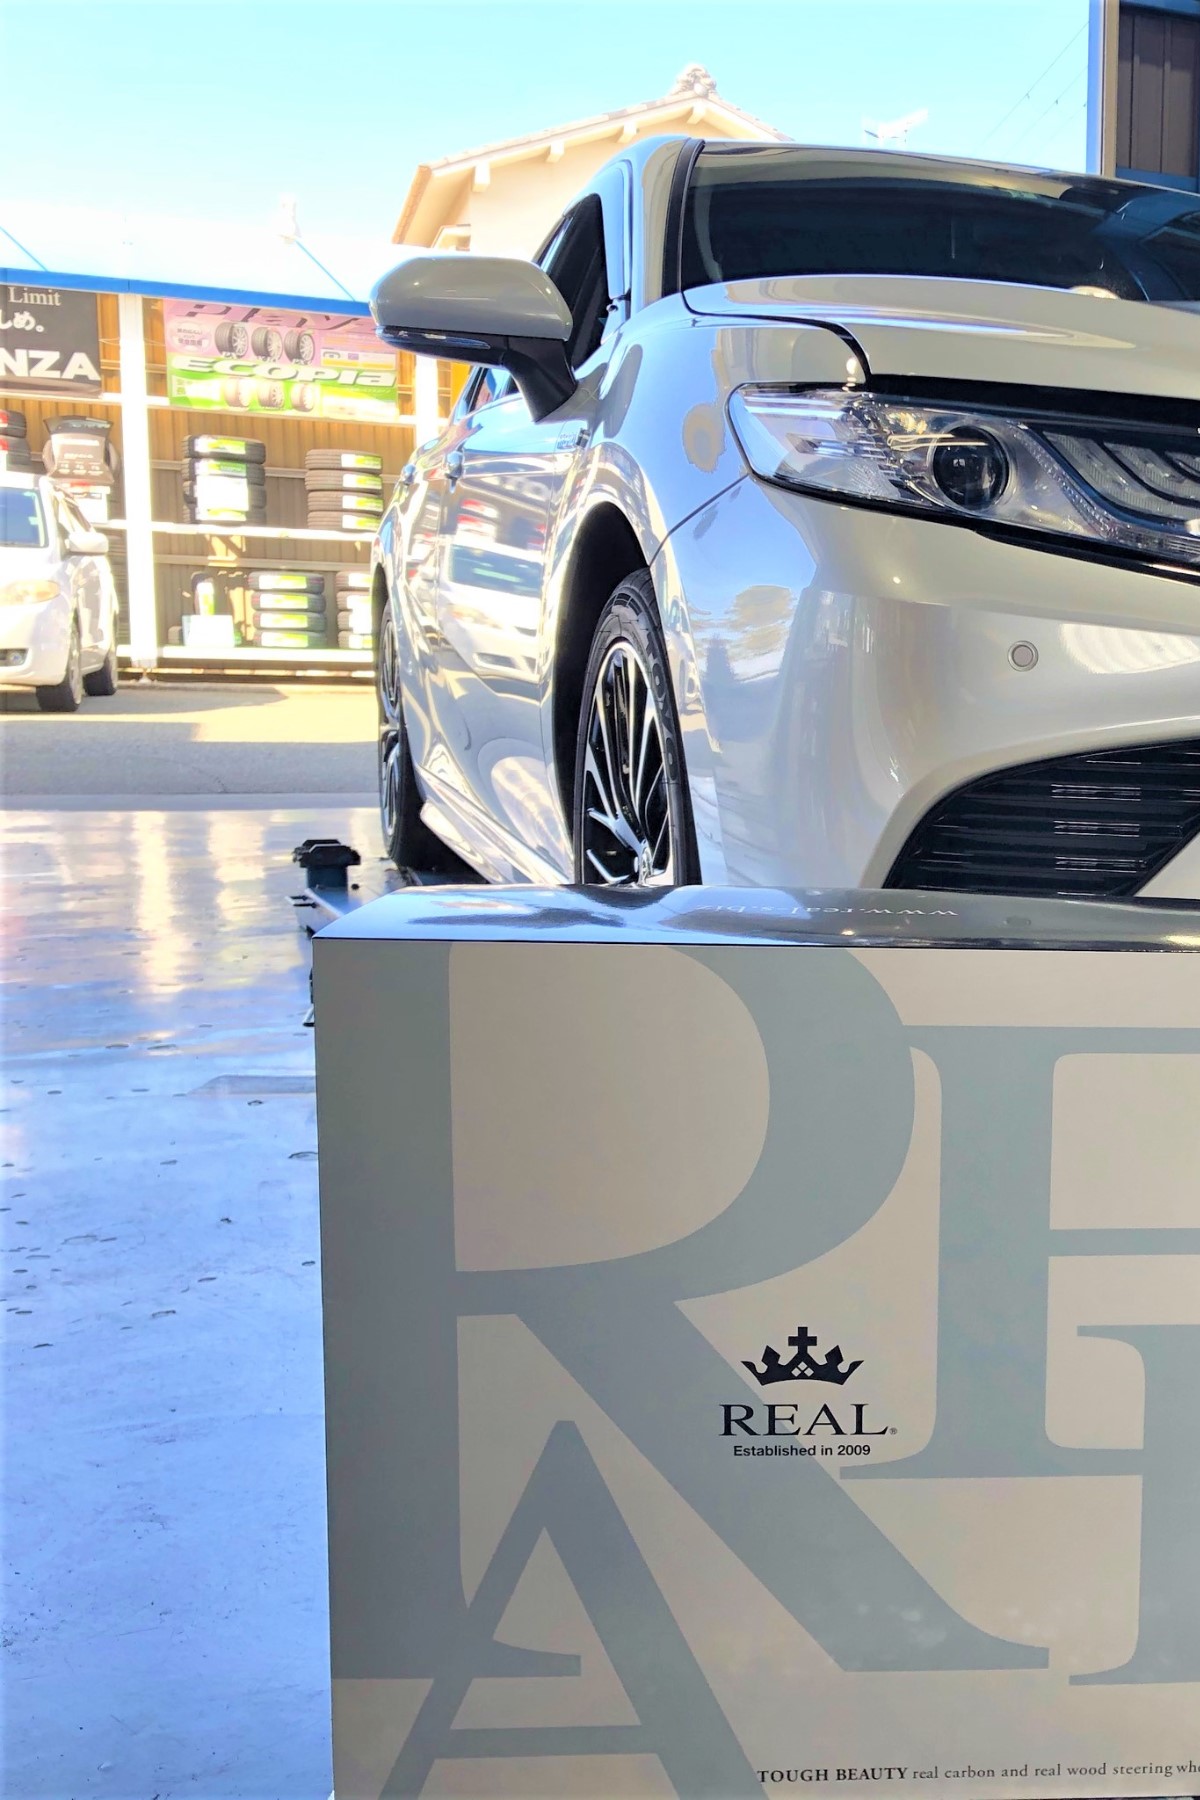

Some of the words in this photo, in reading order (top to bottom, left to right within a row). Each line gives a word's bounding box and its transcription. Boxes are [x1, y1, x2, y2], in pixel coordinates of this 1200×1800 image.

[8, 286, 62, 307] Limit
[733, 1445, 817, 1457] Established
[821, 1445, 834, 1457] in
[837, 1444, 872, 1457] 2009
[757, 1768, 829, 1783] TOUGH
[835, 1766, 909, 1781] BEAUTY
[912, 1765, 939, 1780] real
[943, 1764, 996, 1779] carbon
[1000, 1763, 1028, 1778] and
[1033, 1762, 1061, 1777] real
[1066, 1761, 1107, 1776] wood
[1111, 1761, 1174, 1778] steering
